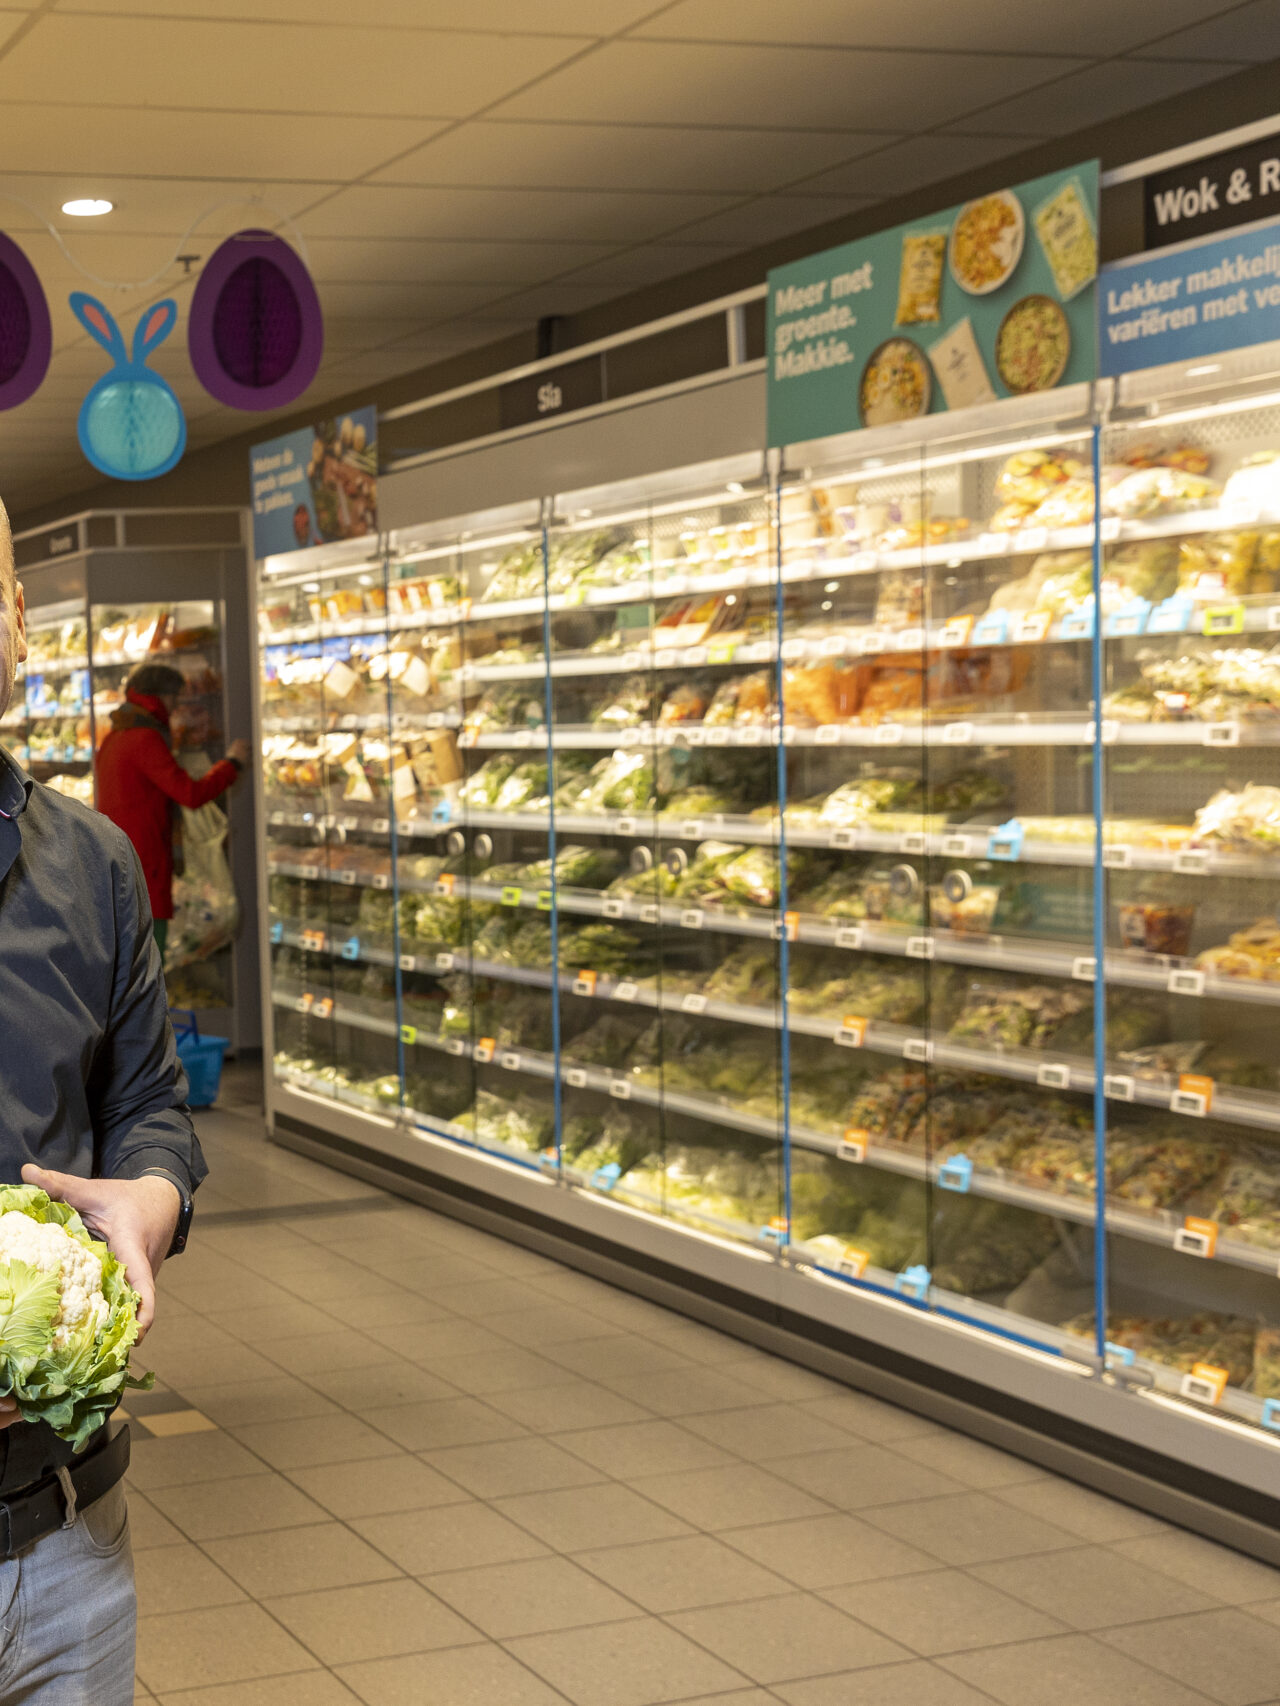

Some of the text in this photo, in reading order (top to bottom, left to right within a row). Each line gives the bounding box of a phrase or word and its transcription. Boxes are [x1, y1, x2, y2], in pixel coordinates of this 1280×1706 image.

[1153, 177, 1219, 226] Wok
[1225, 168, 1252, 205] &
[775, 280, 827, 317] Meer
[830, 261, 873, 300] met
[1107, 278, 1183, 315] Lekker
[775, 304, 857, 353] groente.
[1107, 307, 1197, 345] variëren
[1202, 288, 1249, 322] met
[775, 336, 854, 381] Makkie.
